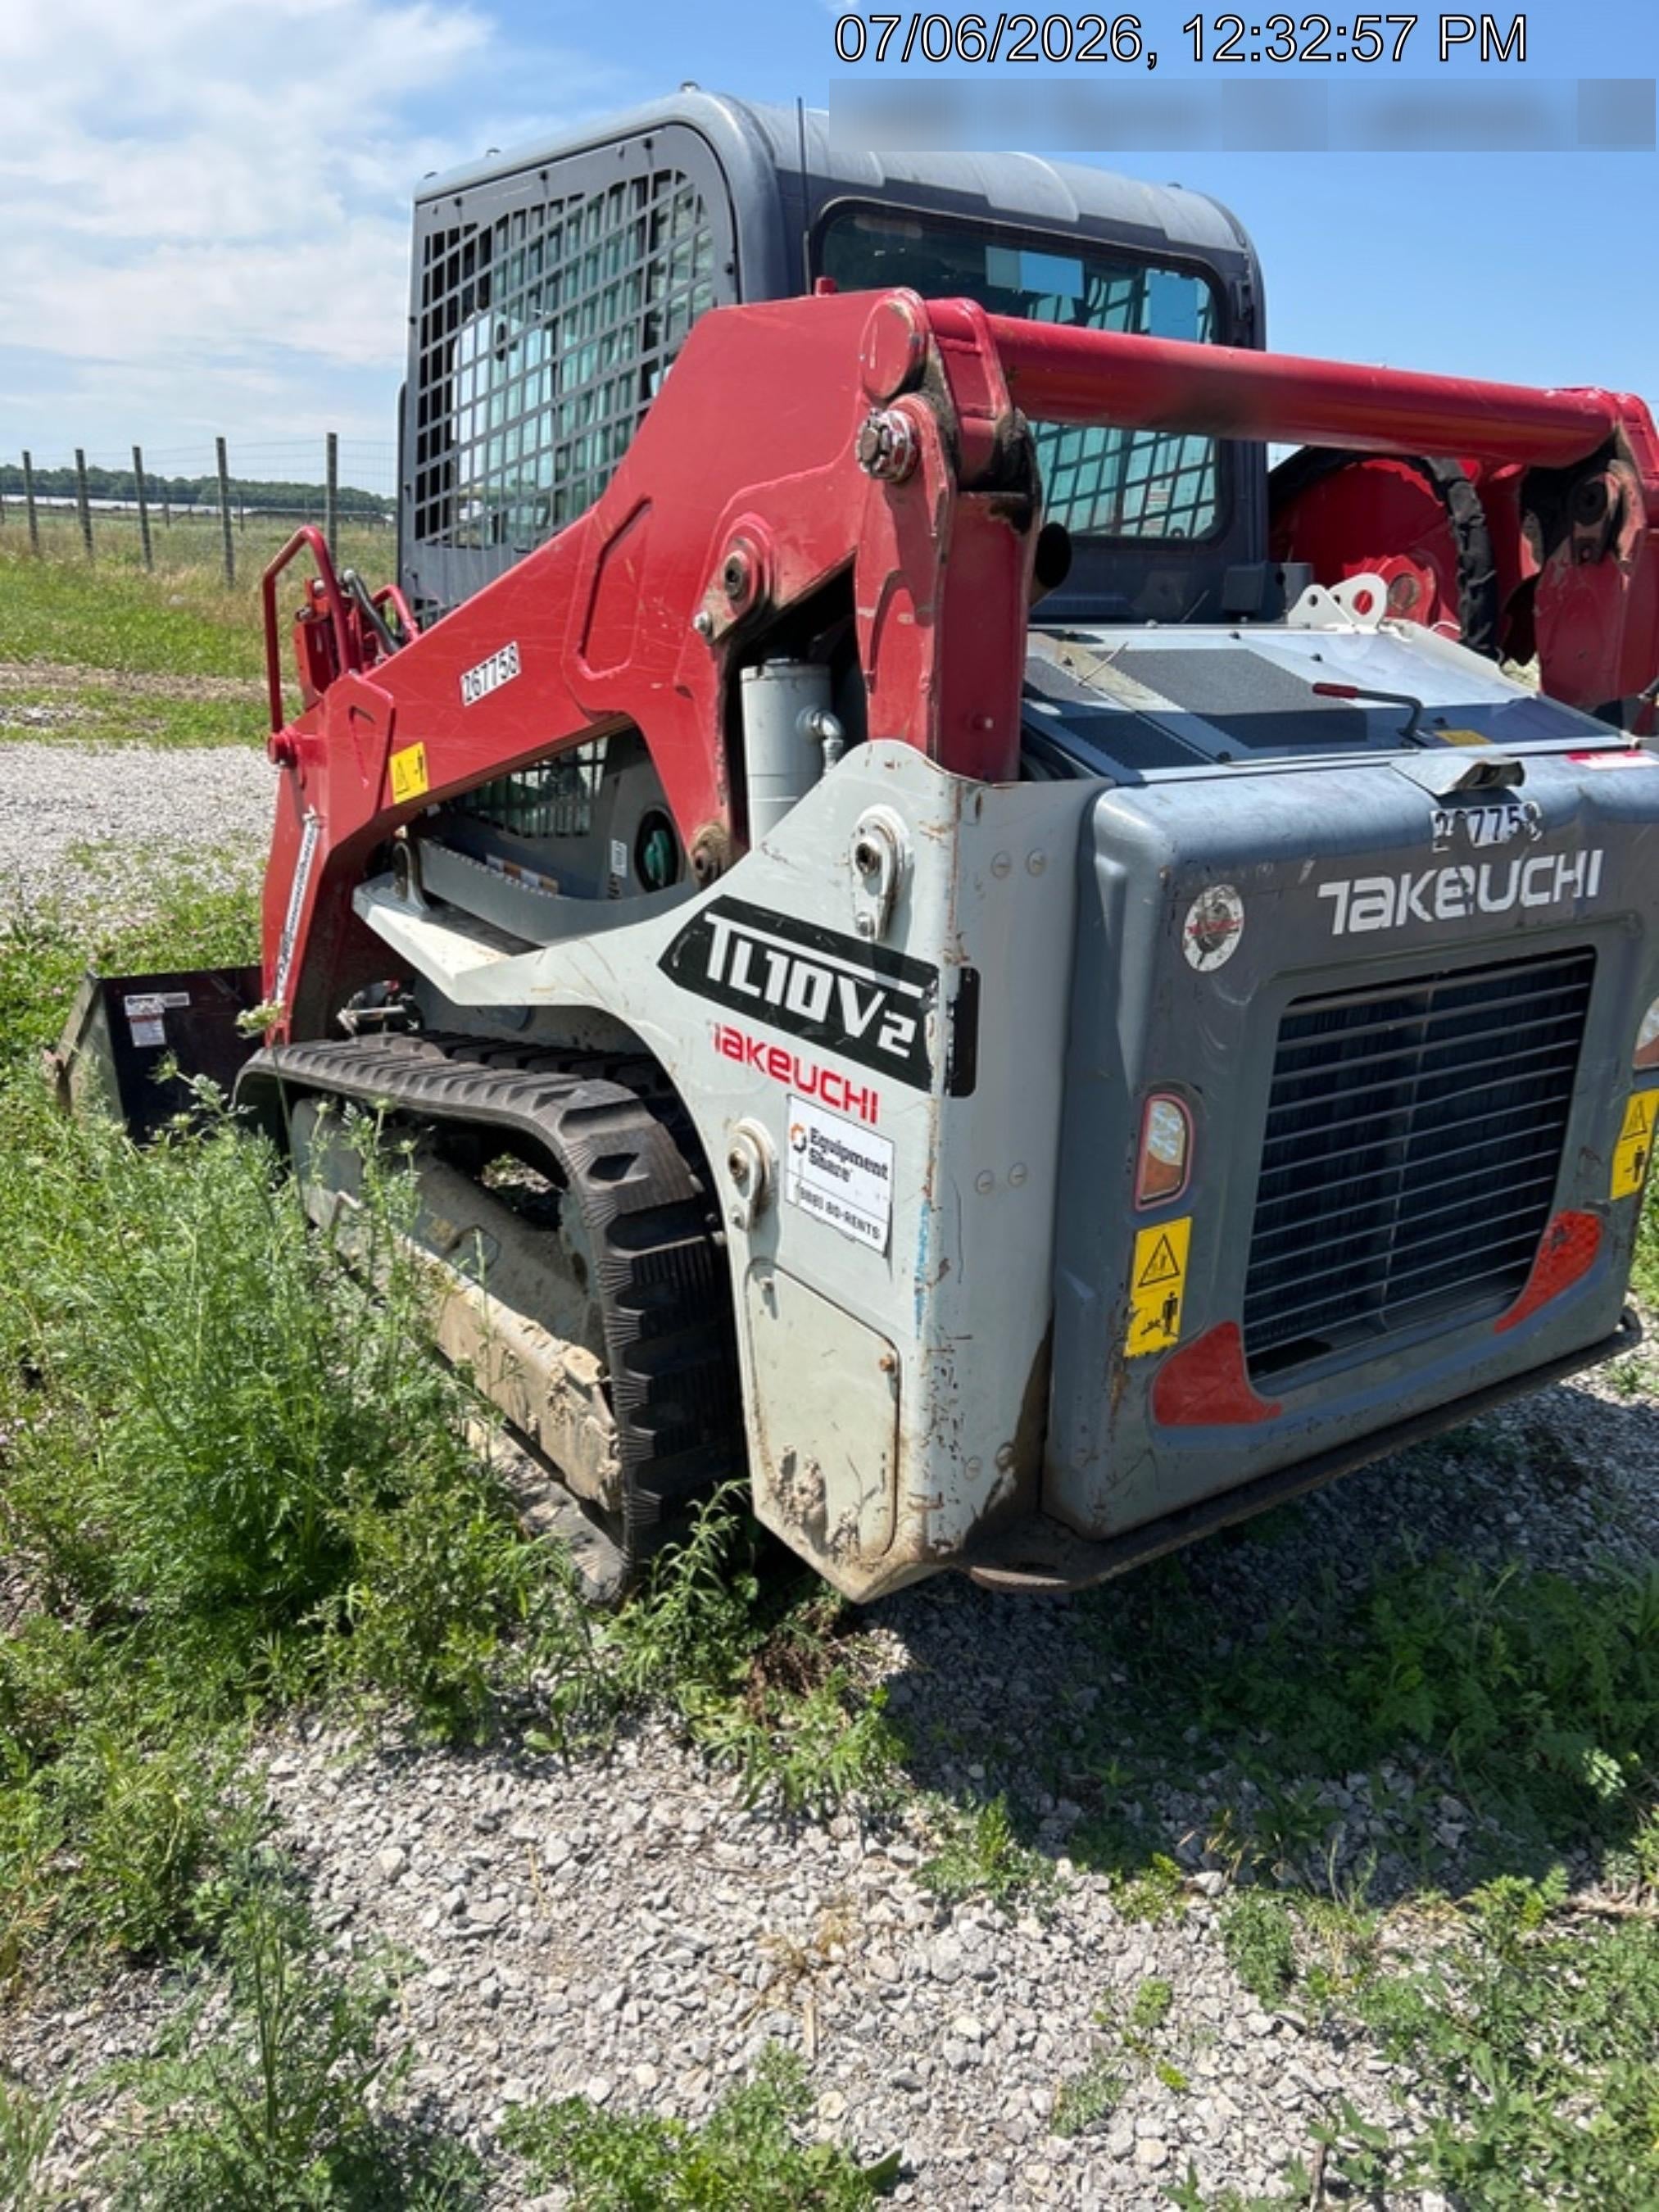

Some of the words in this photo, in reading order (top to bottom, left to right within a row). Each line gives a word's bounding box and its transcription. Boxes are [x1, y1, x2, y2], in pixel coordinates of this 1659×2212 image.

[464, 646, 517, 701] 267758
[809, 1147, 850, 1183] Share
[810, 1127, 889, 1181] Equipment
